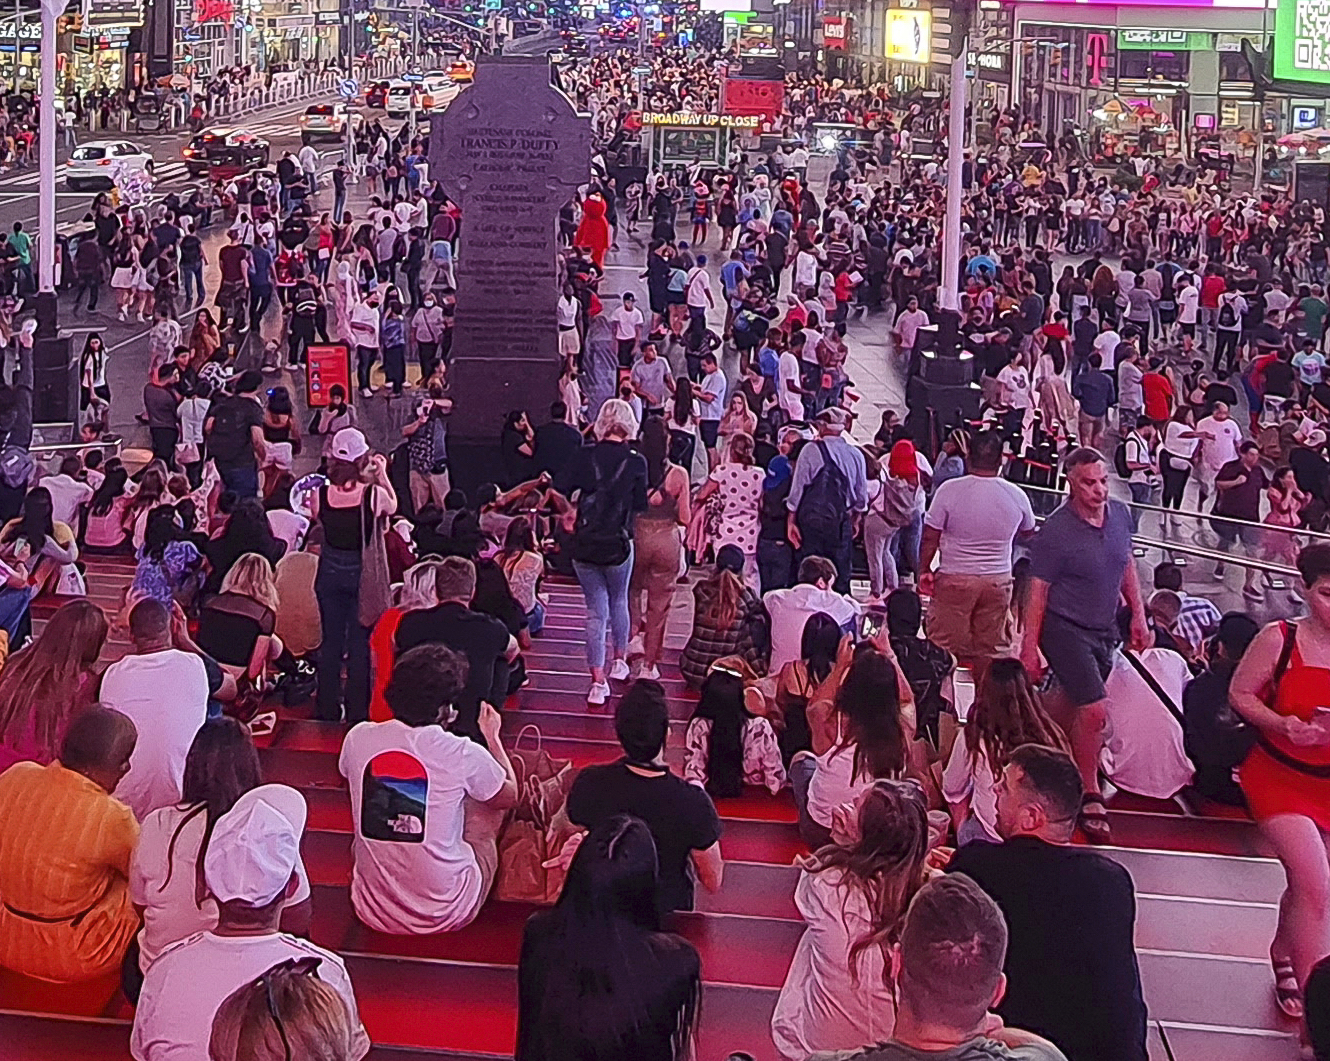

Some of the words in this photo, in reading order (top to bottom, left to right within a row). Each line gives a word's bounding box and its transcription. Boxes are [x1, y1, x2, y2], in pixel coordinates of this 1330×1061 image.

[967, 51, 1003, 70] SEHORA
[642, 112, 701, 125] BROADWAY
[703, 113, 719, 126] UP
[720, 115, 759, 127] CLOSE
[521, 139, 559, 151] DUFFY
